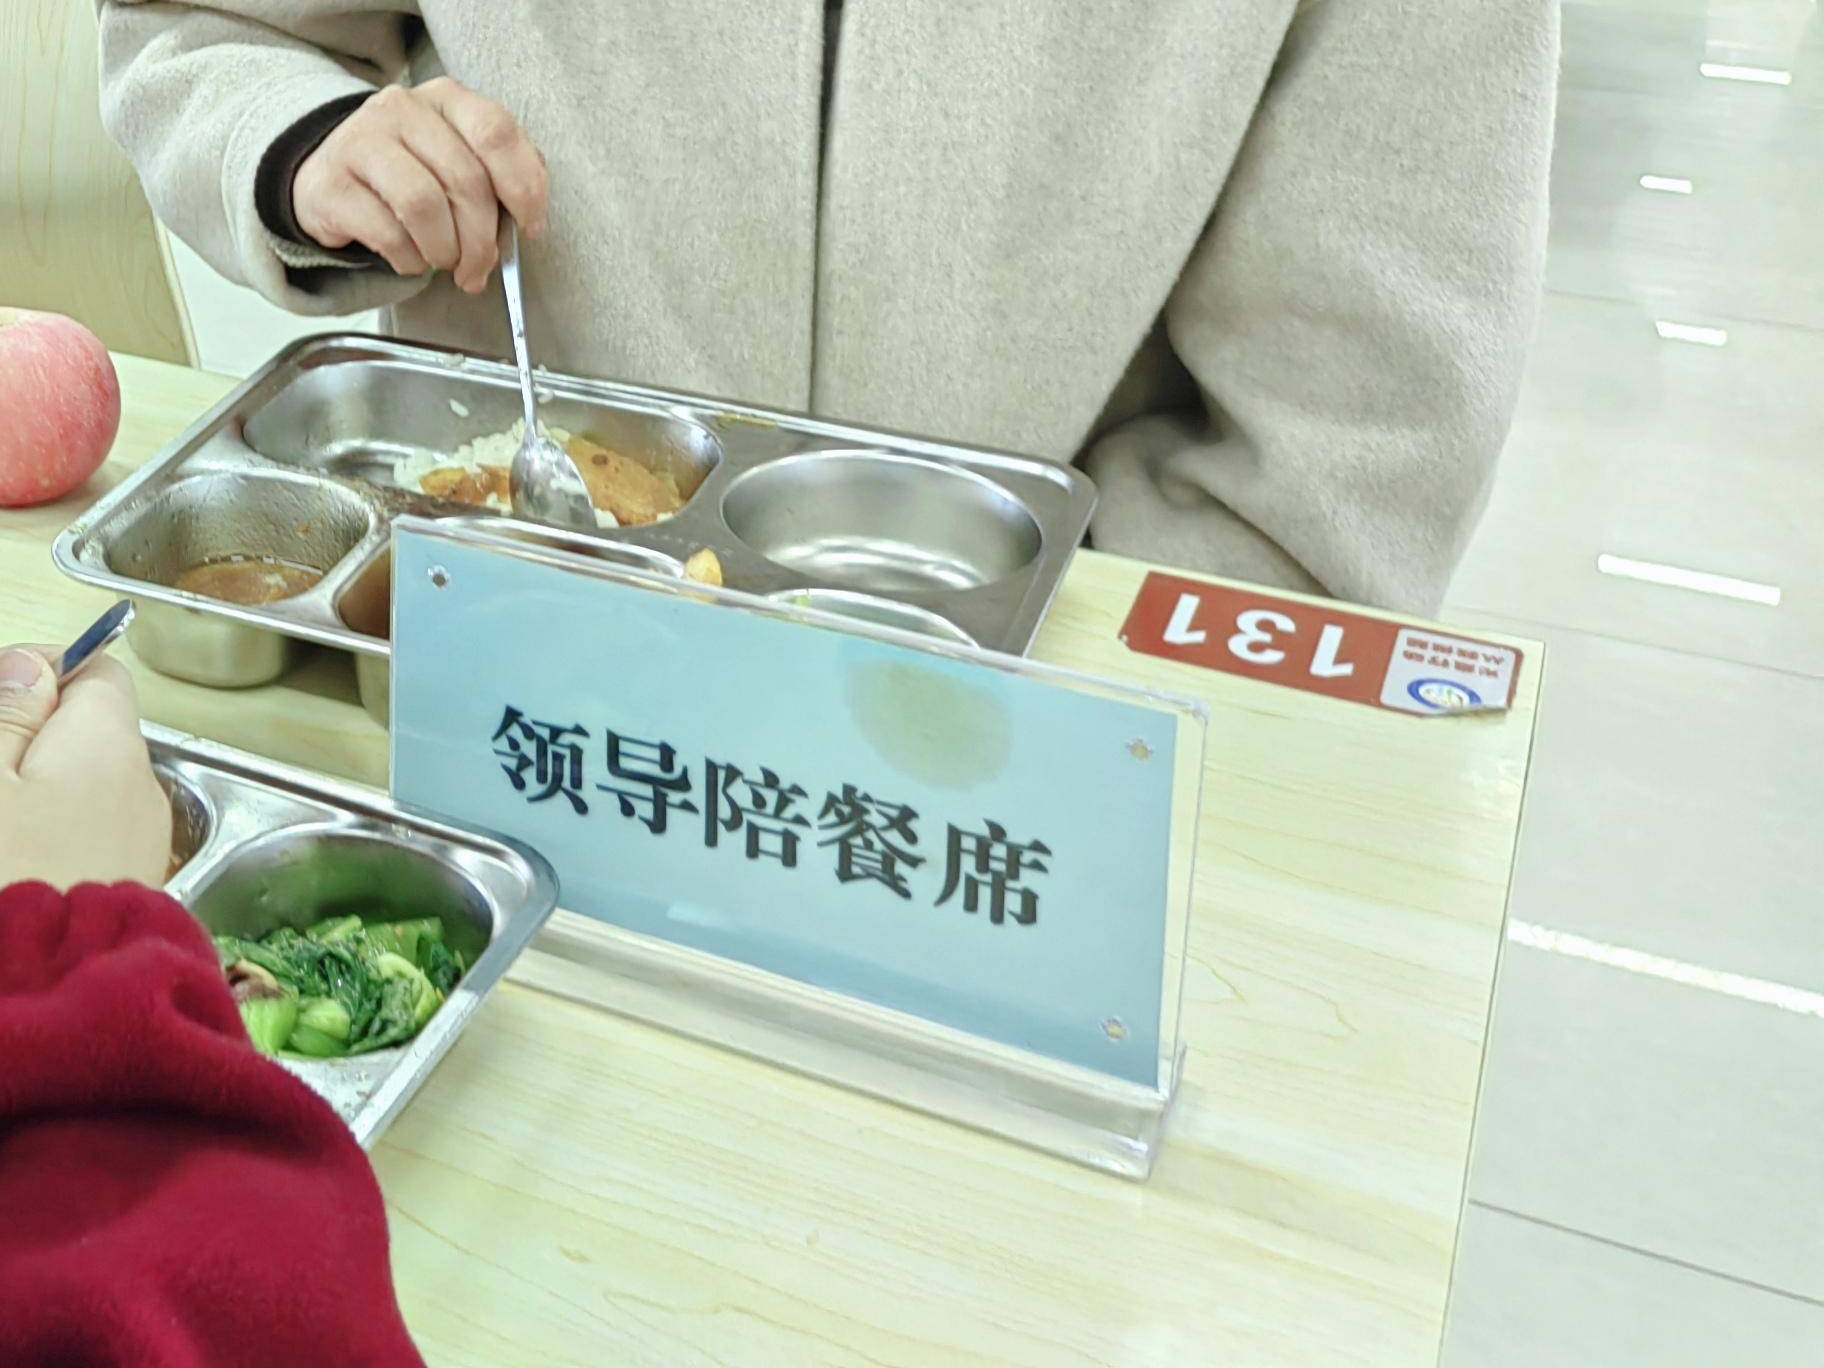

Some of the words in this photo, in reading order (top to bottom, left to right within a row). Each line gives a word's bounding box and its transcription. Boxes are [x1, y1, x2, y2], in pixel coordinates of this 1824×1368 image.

[1163, 593, 1354, 678] 131
[491, 705, 1052, 925] 领导陪餐席
